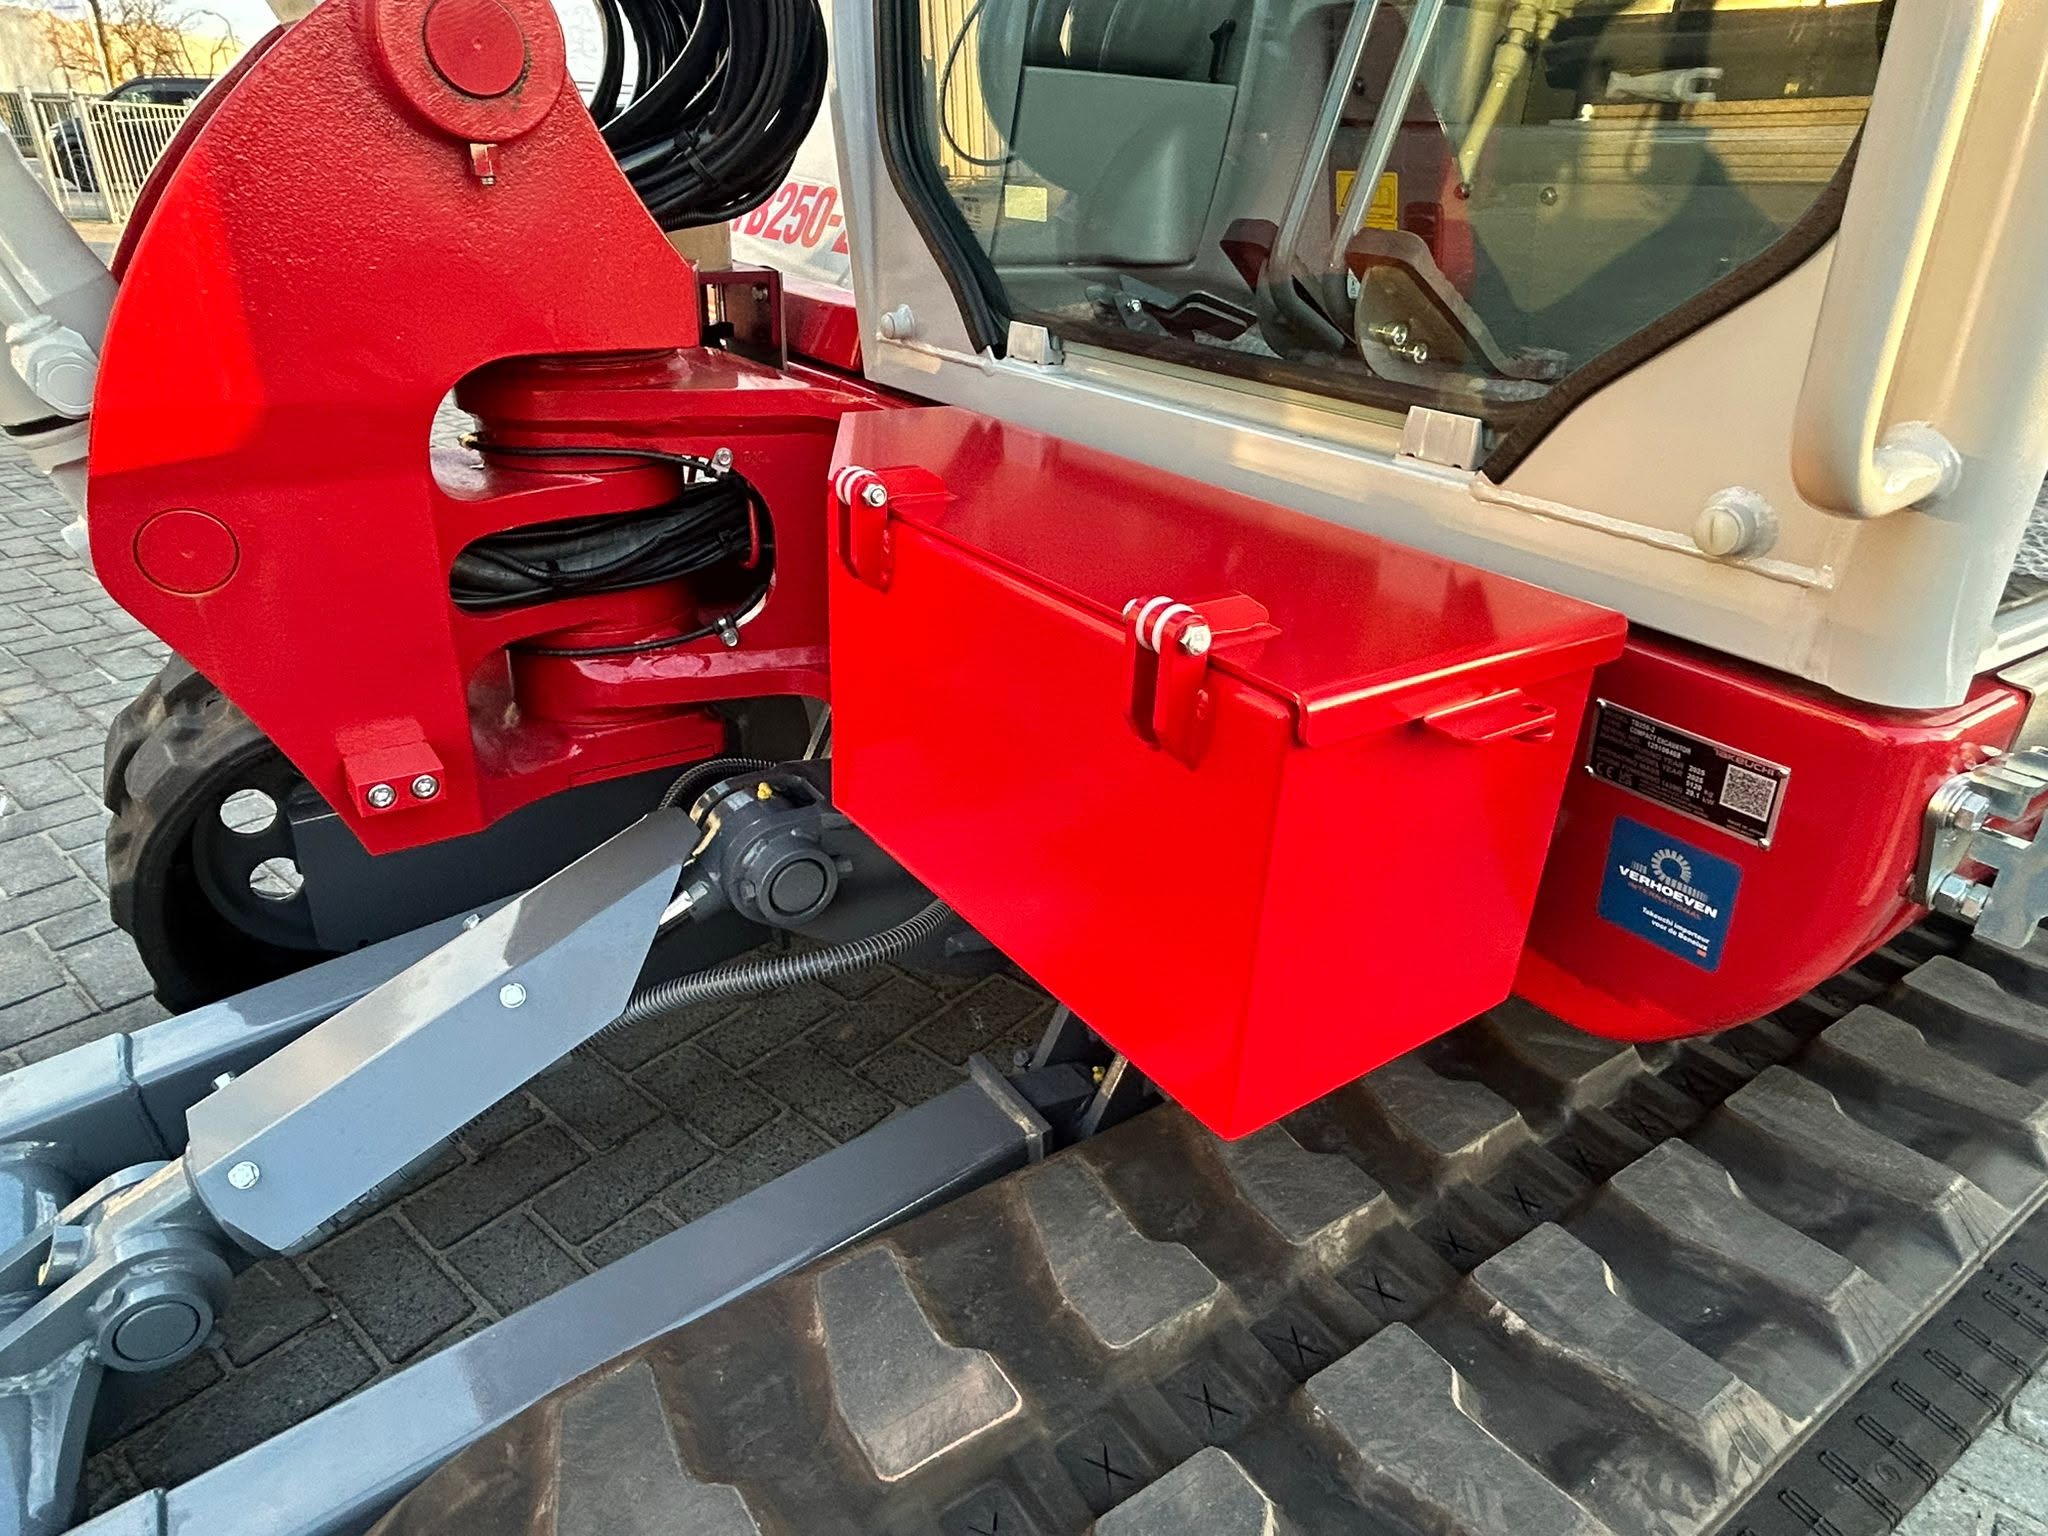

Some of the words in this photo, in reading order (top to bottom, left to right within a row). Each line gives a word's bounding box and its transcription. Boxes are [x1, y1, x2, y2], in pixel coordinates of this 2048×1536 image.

[1629, 726, 1657, 742] COMPACT
[1656, 736, 1692, 756] EXCAVATOR
[1618, 865, 1718, 919] VERHOEVEN
[1642, 906, 1674, 927] Takeuchi
[1674, 922, 1710, 945] importeur
[1651, 919, 1667, 931] voor
[1668, 927, 1677, 936] de
[1678, 932, 1708, 951] Benelux
